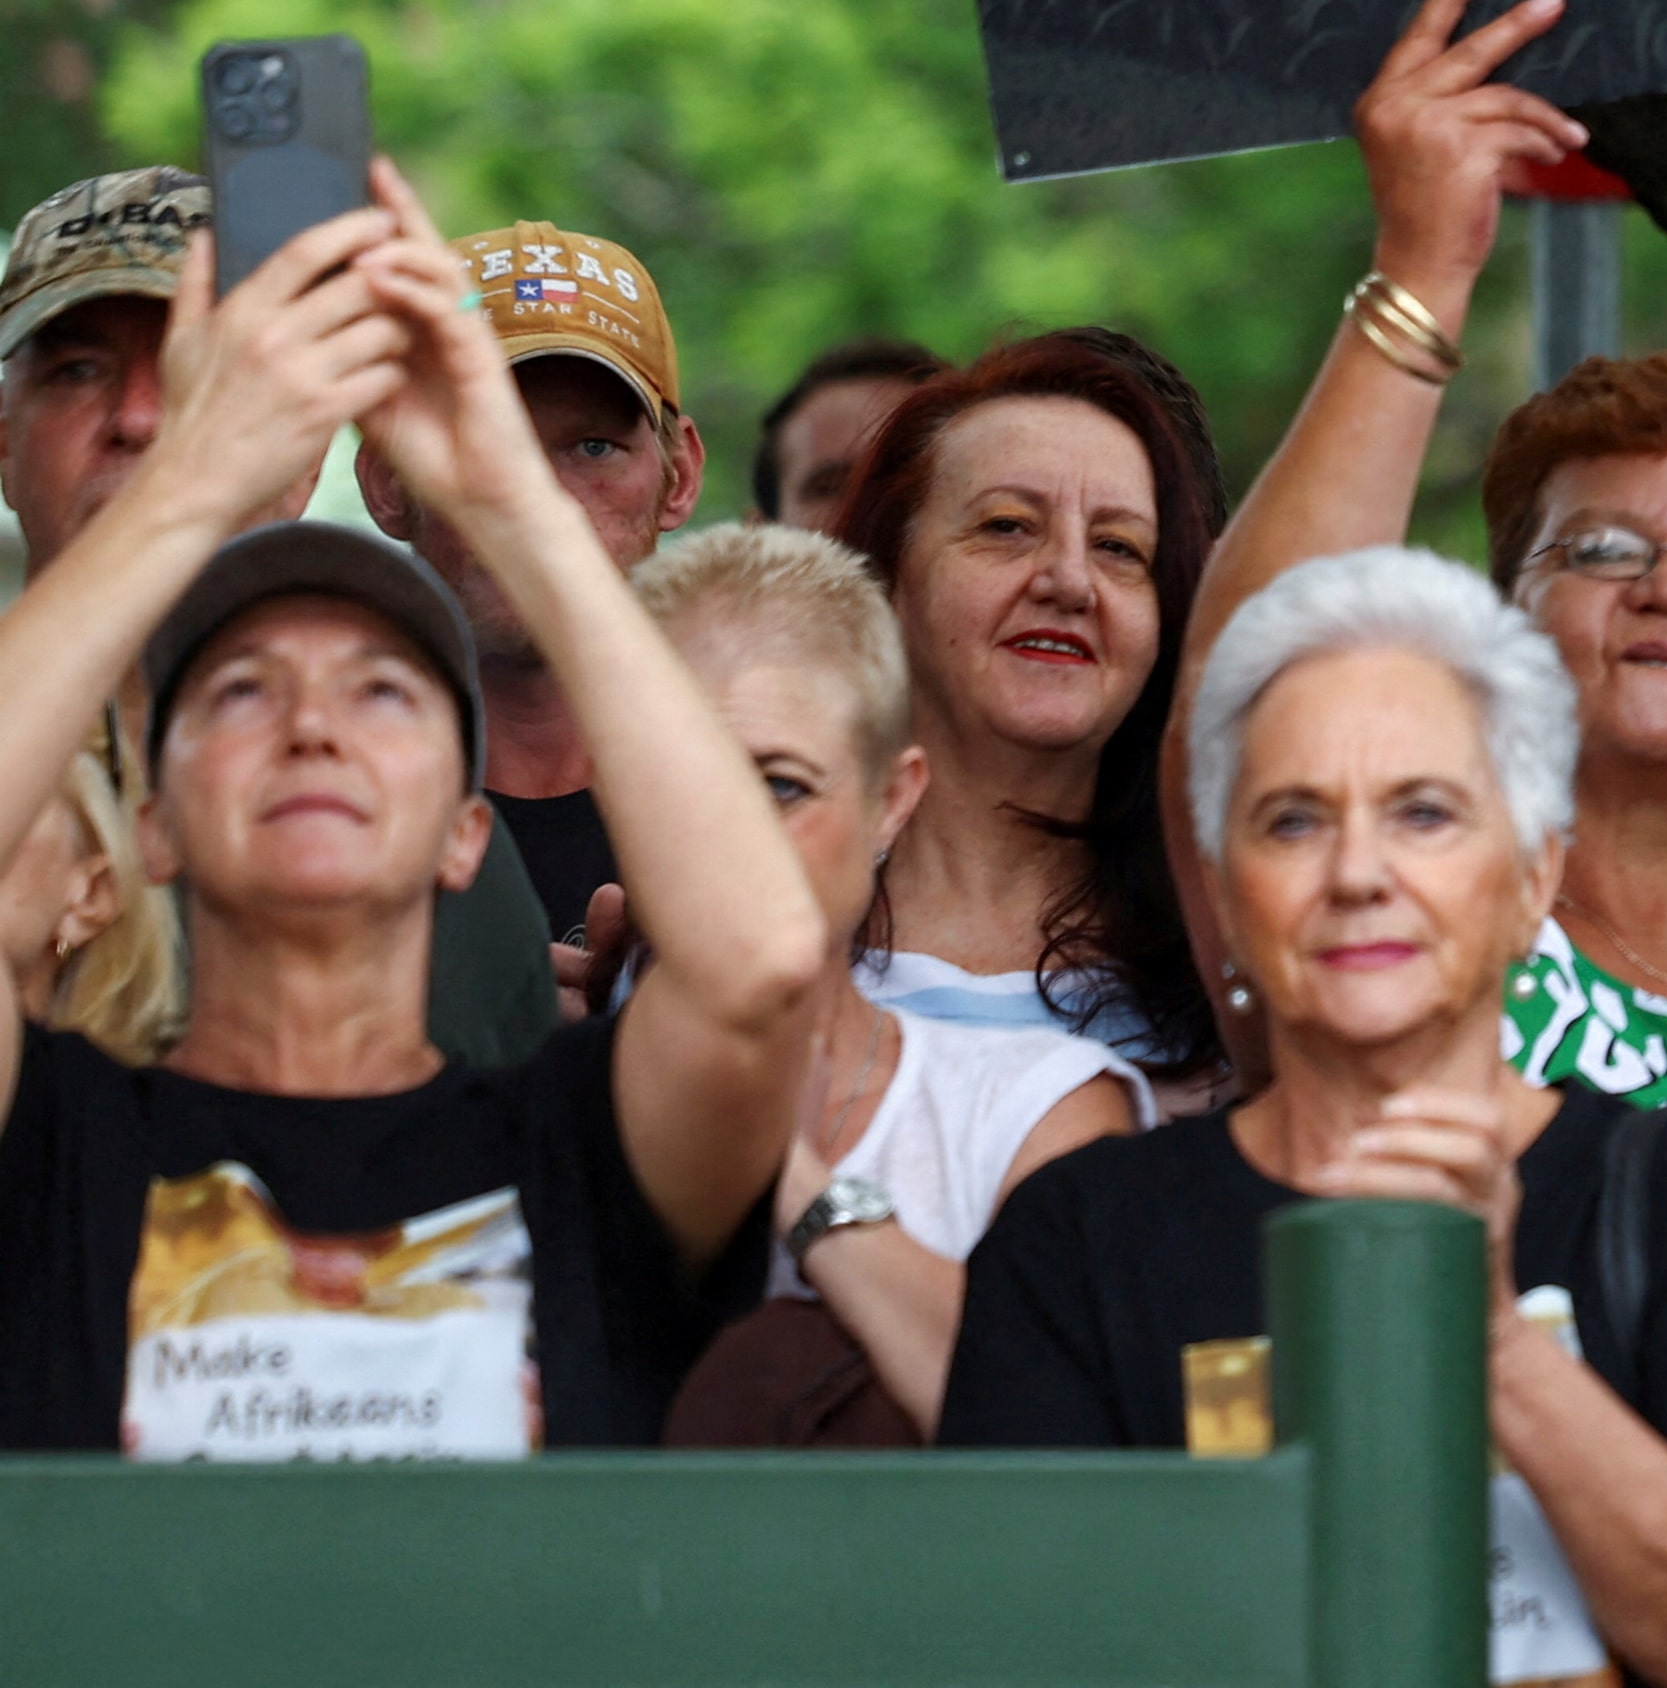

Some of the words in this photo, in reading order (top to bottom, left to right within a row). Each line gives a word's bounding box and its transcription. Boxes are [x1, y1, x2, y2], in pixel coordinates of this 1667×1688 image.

[461, 244, 639, 302] EXAS
[512, 302, 573, 316] STAR
[588, 310, 641, 349] STATE
[153, 1333, 294, 1389] Make
